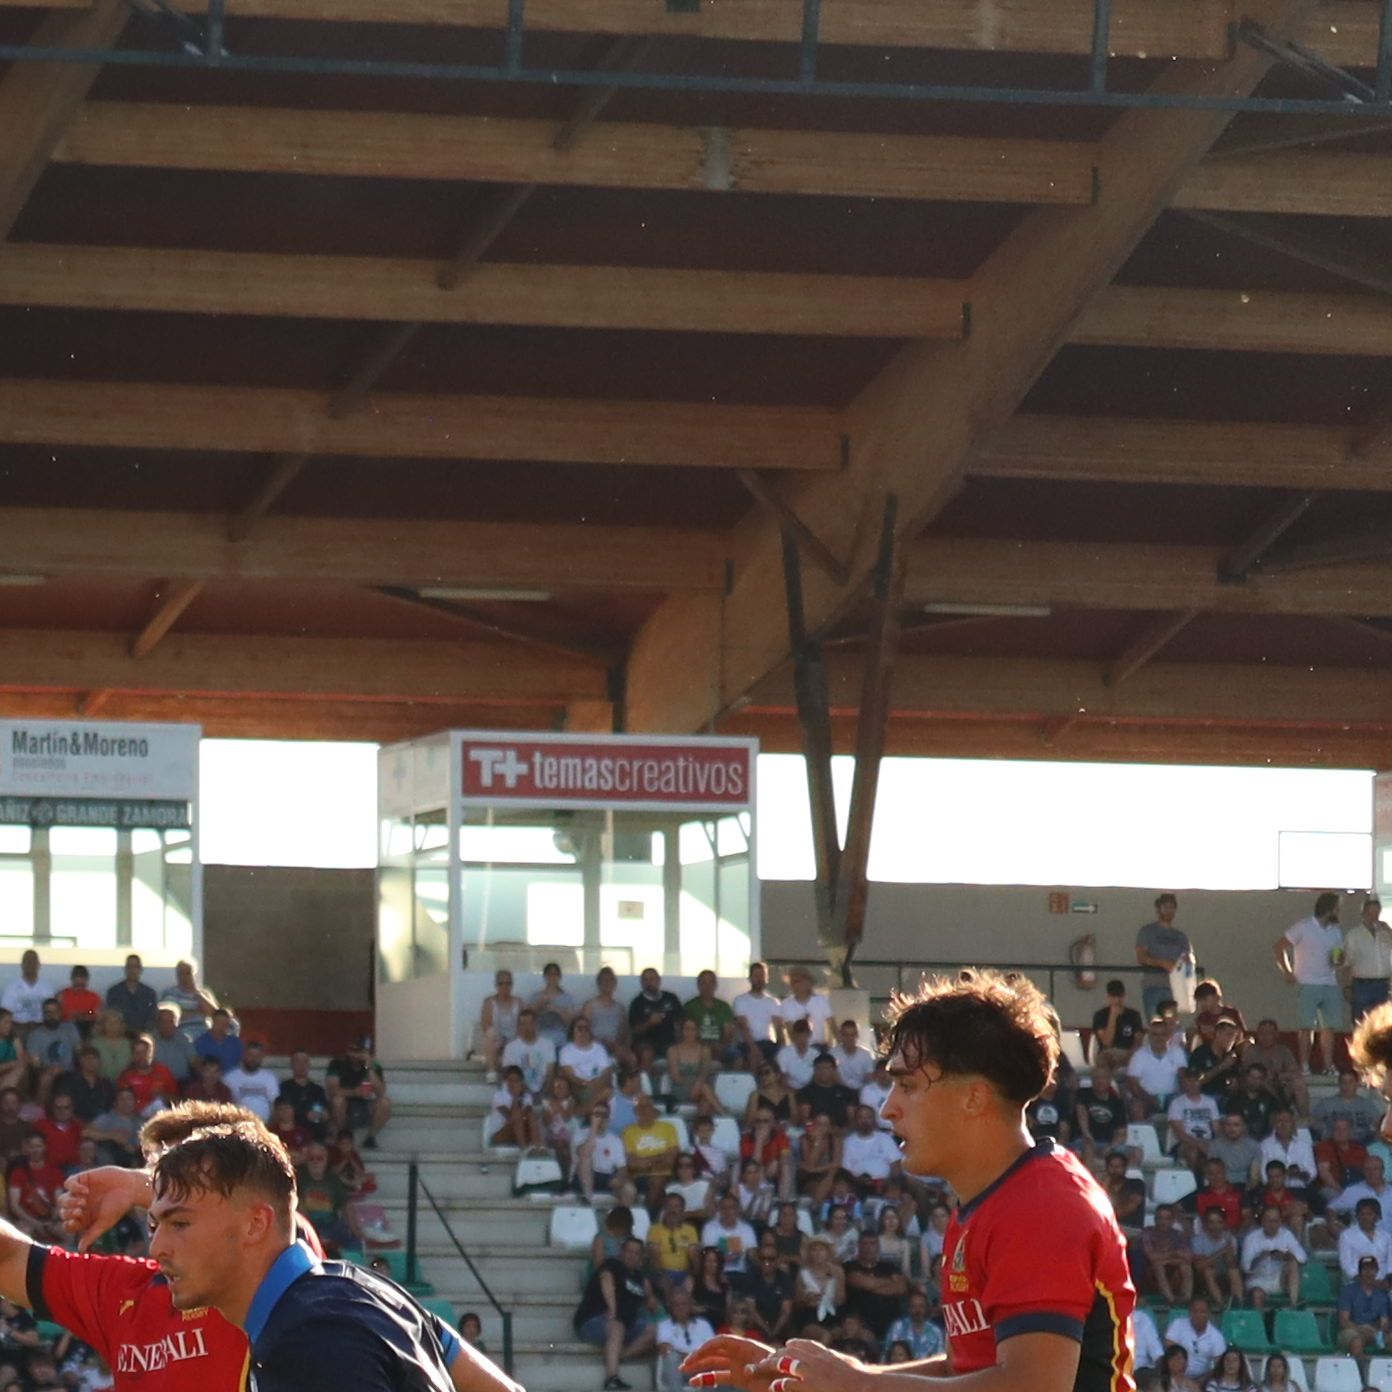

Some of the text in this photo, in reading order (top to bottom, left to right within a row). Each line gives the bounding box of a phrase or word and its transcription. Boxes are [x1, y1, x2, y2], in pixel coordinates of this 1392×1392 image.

[12, 730, 149, 758] Martín&Moreno
[533, 751, 743, 795] temascreativos
[56, 803, 116, 823] GRANDE
[123, 805, 189, 825] ZAMORA
